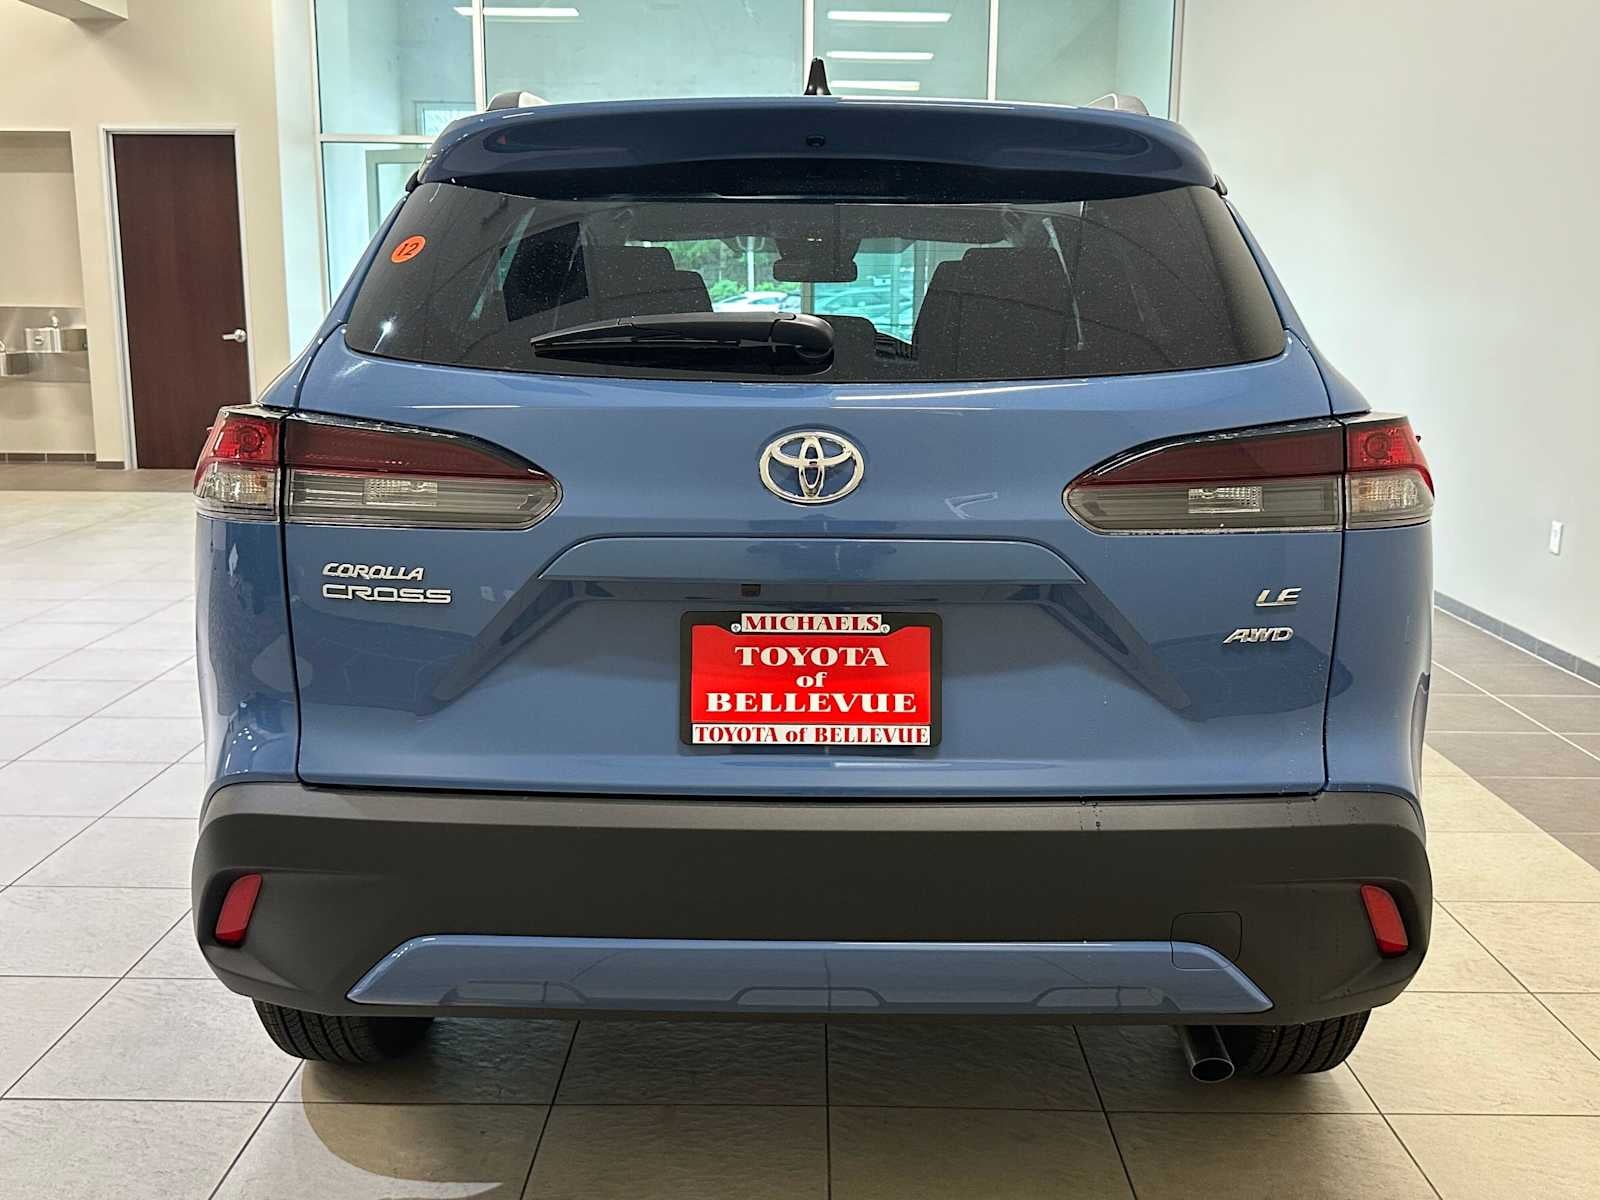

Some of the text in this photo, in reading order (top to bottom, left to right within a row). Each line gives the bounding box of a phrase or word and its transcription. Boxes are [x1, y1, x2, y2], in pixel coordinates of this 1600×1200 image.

[397, 242, 419, 256] 12
[322, 562, 424, 580] COROLLA
[322, 583, 452, 603] CROSS
[1256, 587, 1302, 607] LE
[745, 615, 881, 631] MICHAELS
[1223, 627, 1294, 643] AWD
[734, 646, 889, 667] TOYOTA
[796, 672, 828, 688] of
[705, 692, 917, 713] BELLEVUE
[695, 726, 929, 744] TOYOTA of BELLEVUE
